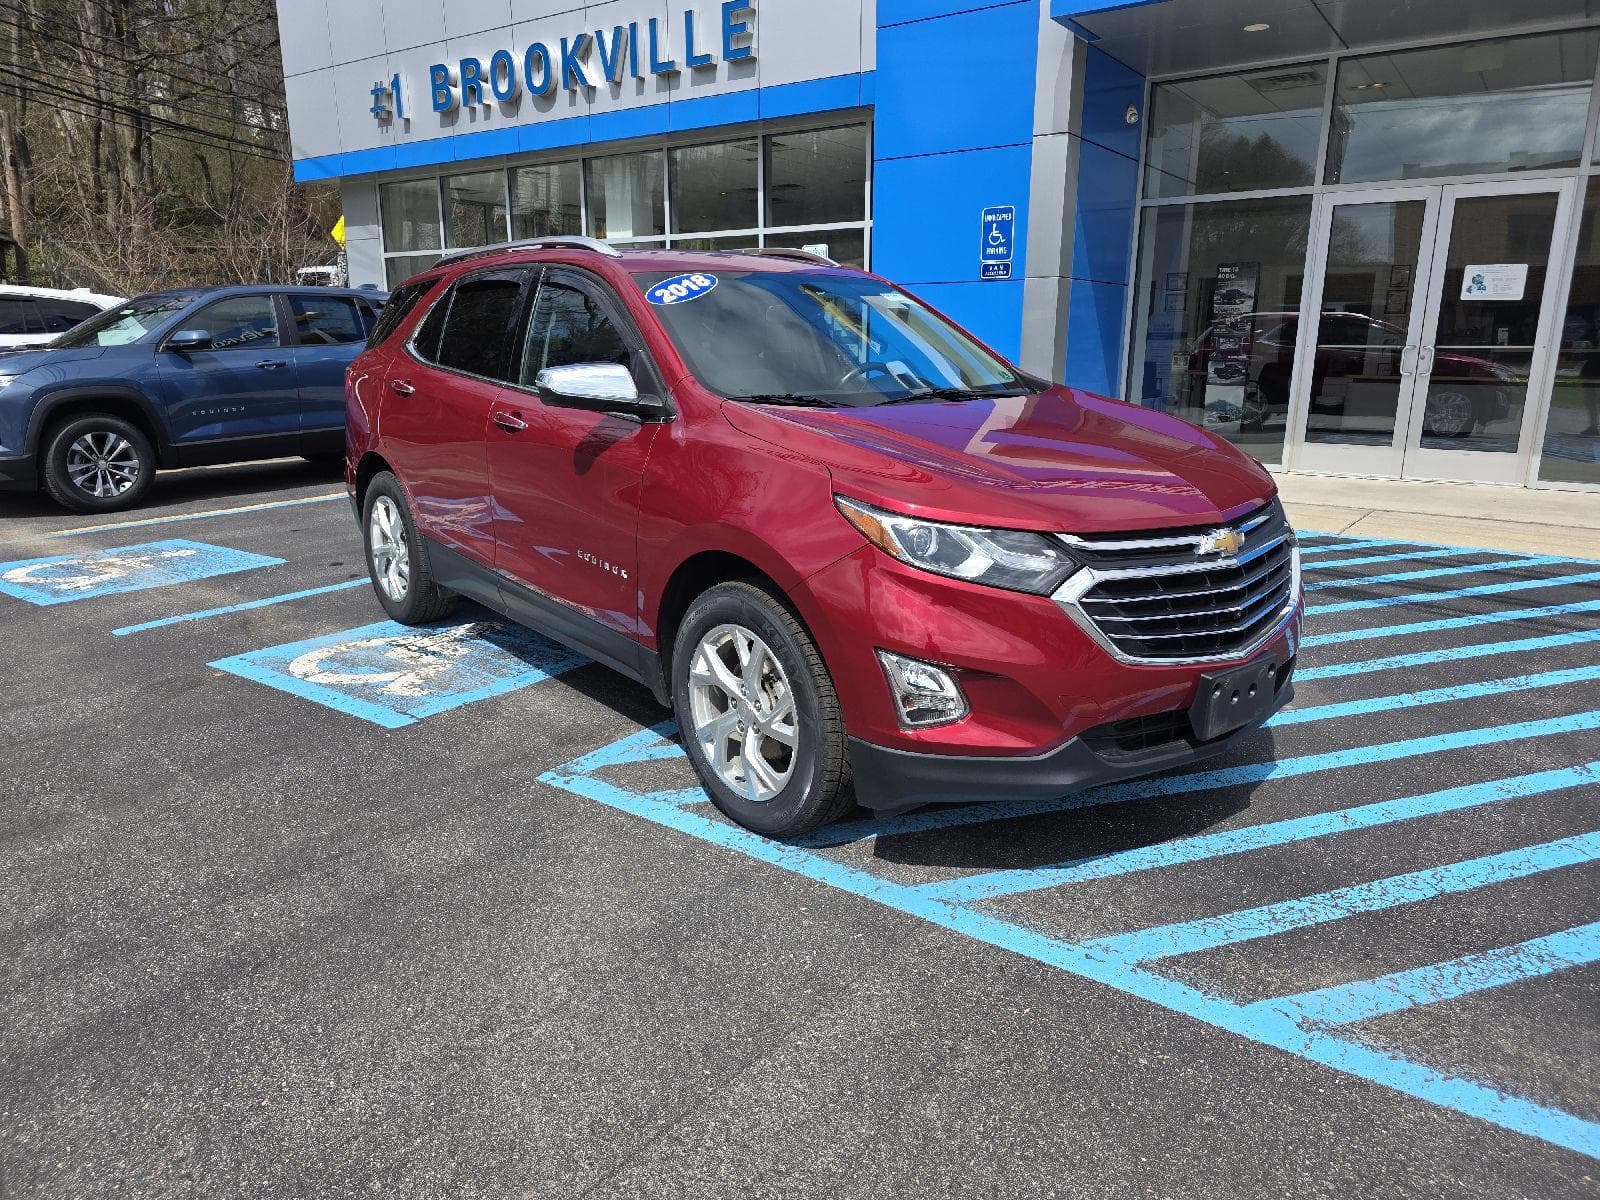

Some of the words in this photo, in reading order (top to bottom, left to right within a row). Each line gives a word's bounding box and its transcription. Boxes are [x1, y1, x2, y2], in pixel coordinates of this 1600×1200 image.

[369, 72, 410, 120] #1
[429, 0, 757, 113] BROOKVILLE
[654, 274, 712, 303] 2018
[191, 406, 245, 416] EQUINOX
[577, 549, 629, 579] EQUINOX
